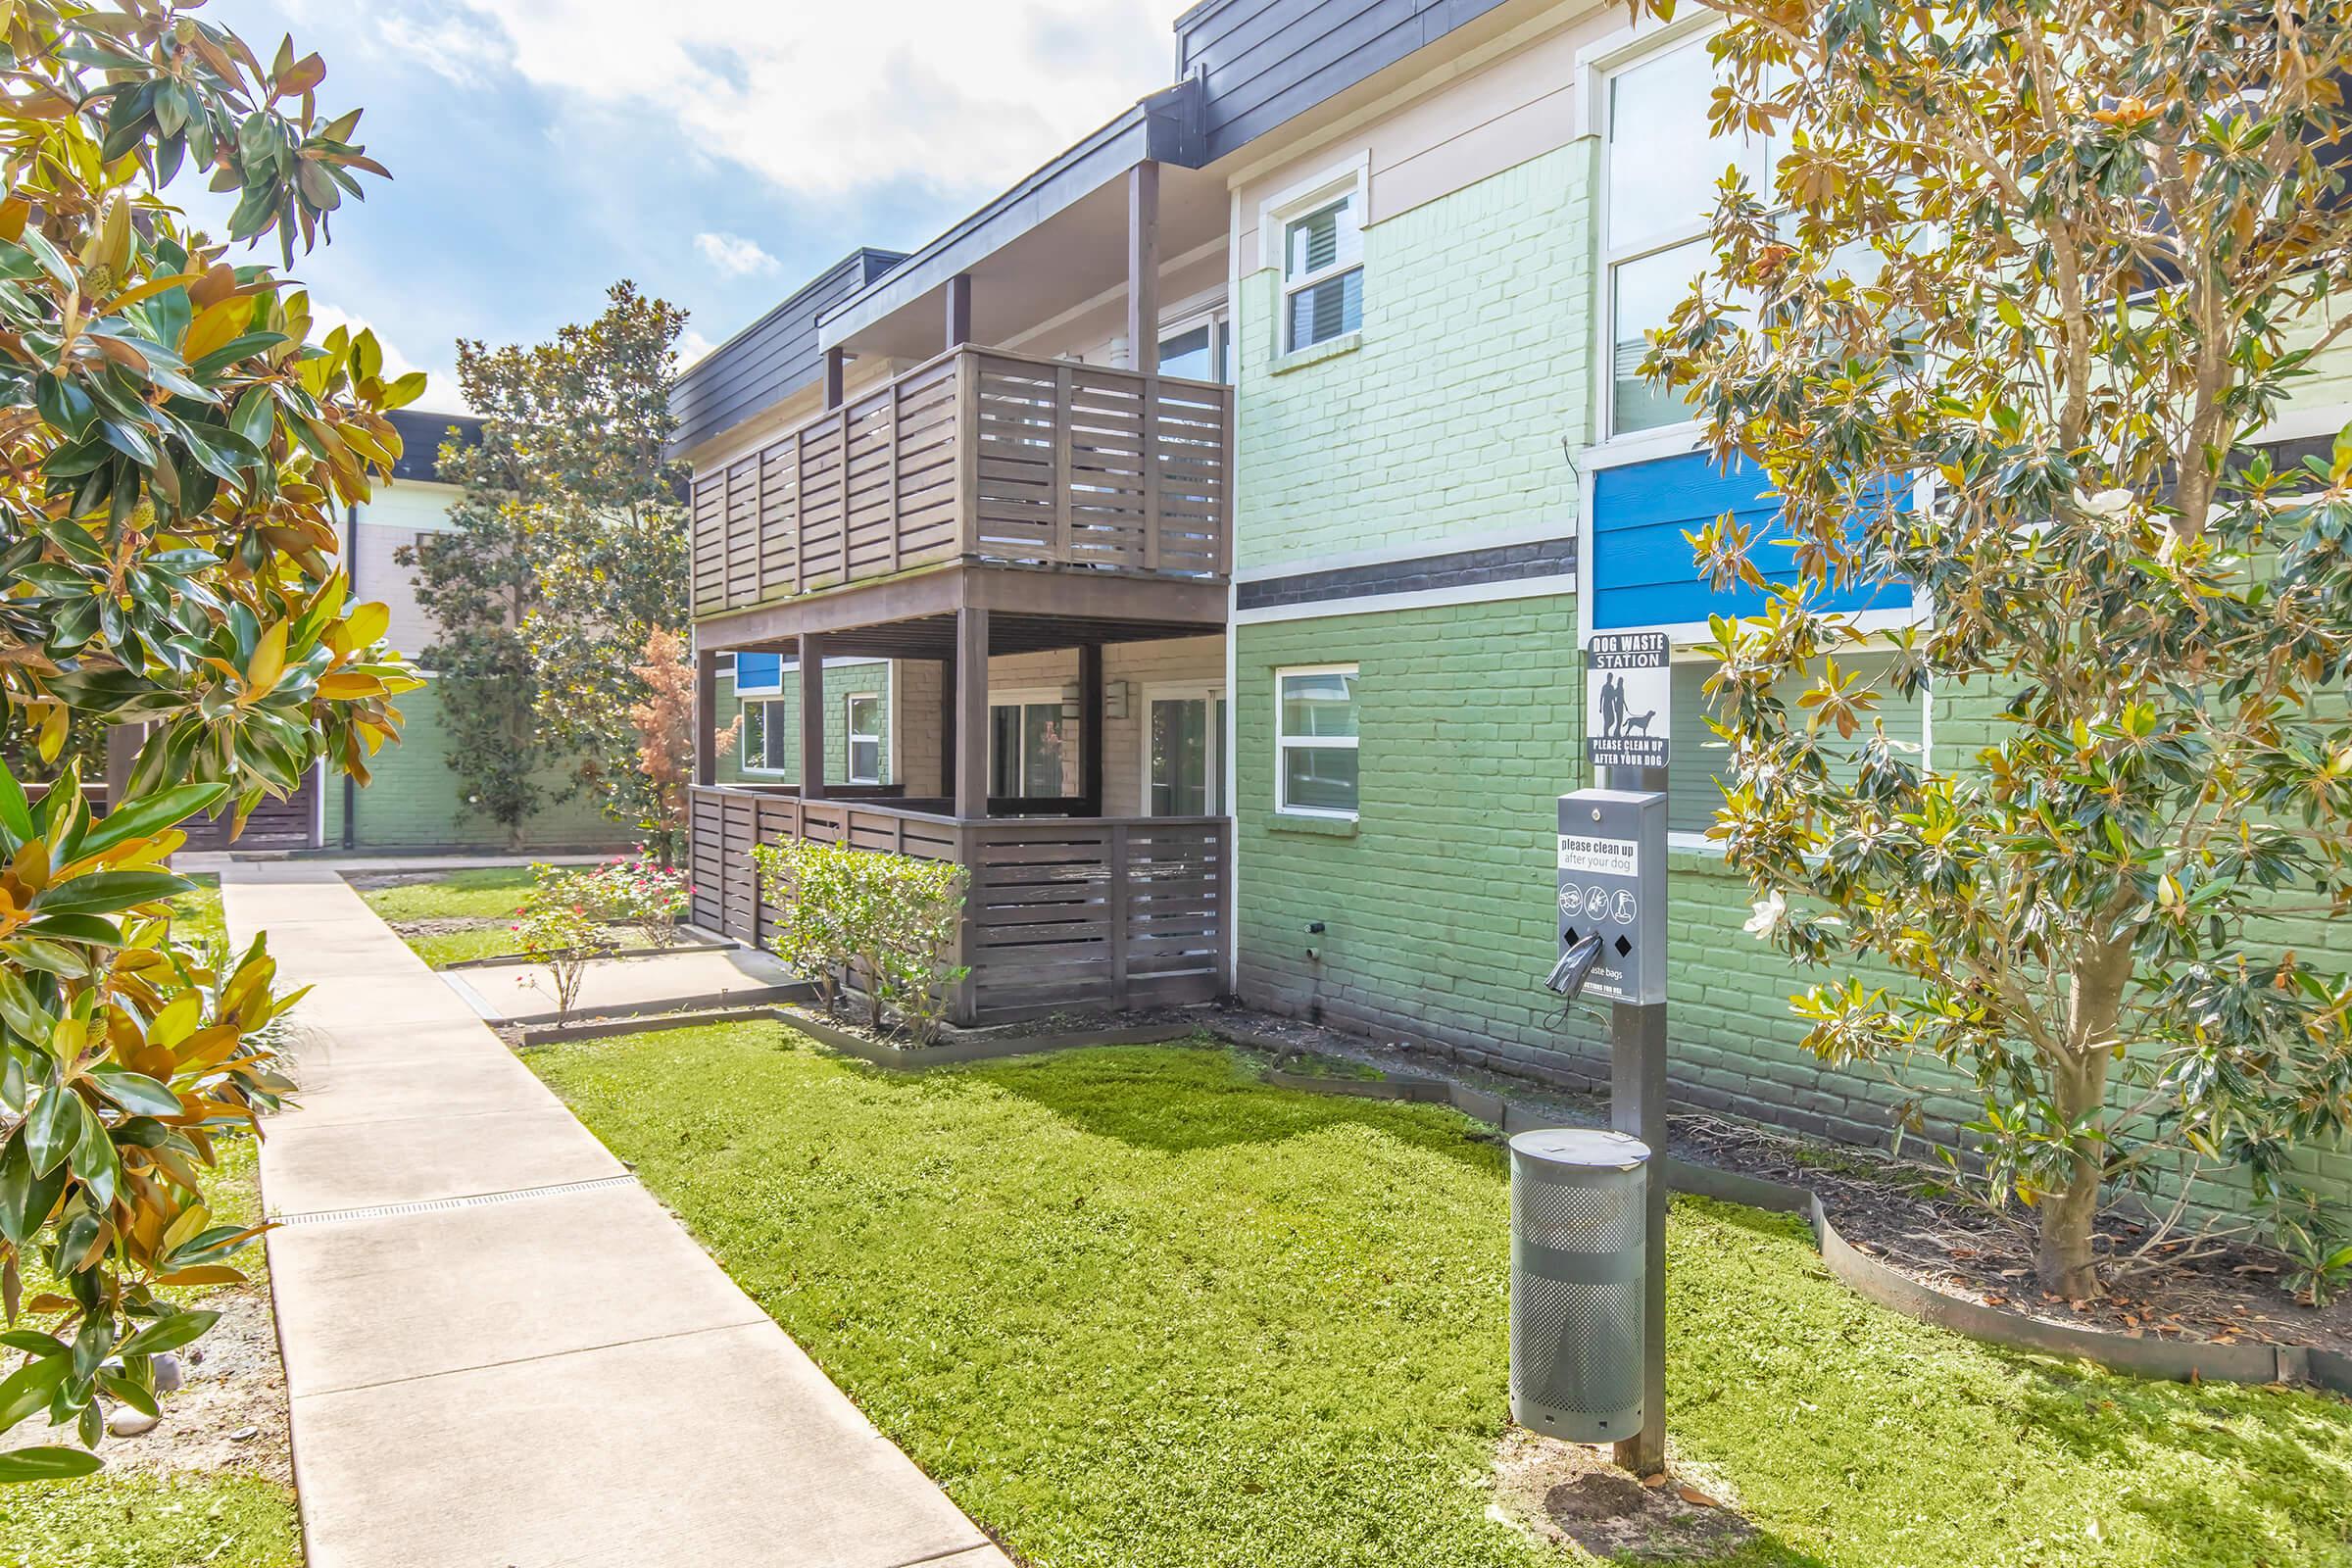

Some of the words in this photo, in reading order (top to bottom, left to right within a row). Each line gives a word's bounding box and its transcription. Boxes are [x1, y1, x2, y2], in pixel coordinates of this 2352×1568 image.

[1593, 637, 1617, 652] DOG
[1621, 634, 1663, 651] WASTE
[1597, 654, 1659, 667] STATION
[1593, 740, 1622, 751] PLEASE
[1624, 740, 1649, 751] CLEAN
[1651, 741, 1663, 752] UP
[1594, 754, 1618, 764] AFTER
[1621, 755, 1642, 765] YOUR
[1644, 755, 1662, 765] DOG
[1562, 839, 1592, 853] please
[1593, 842, 1619, 856] clean
[1622, 846, 1634, 858] up
[1565, 852, 1586, 864] after
[1588, 856, 1610, 868] your
[1611, 857, 1631, 871] dog
[1591, 966, 1604, 976] aste
[1605, 967, 1623, 980] bags
